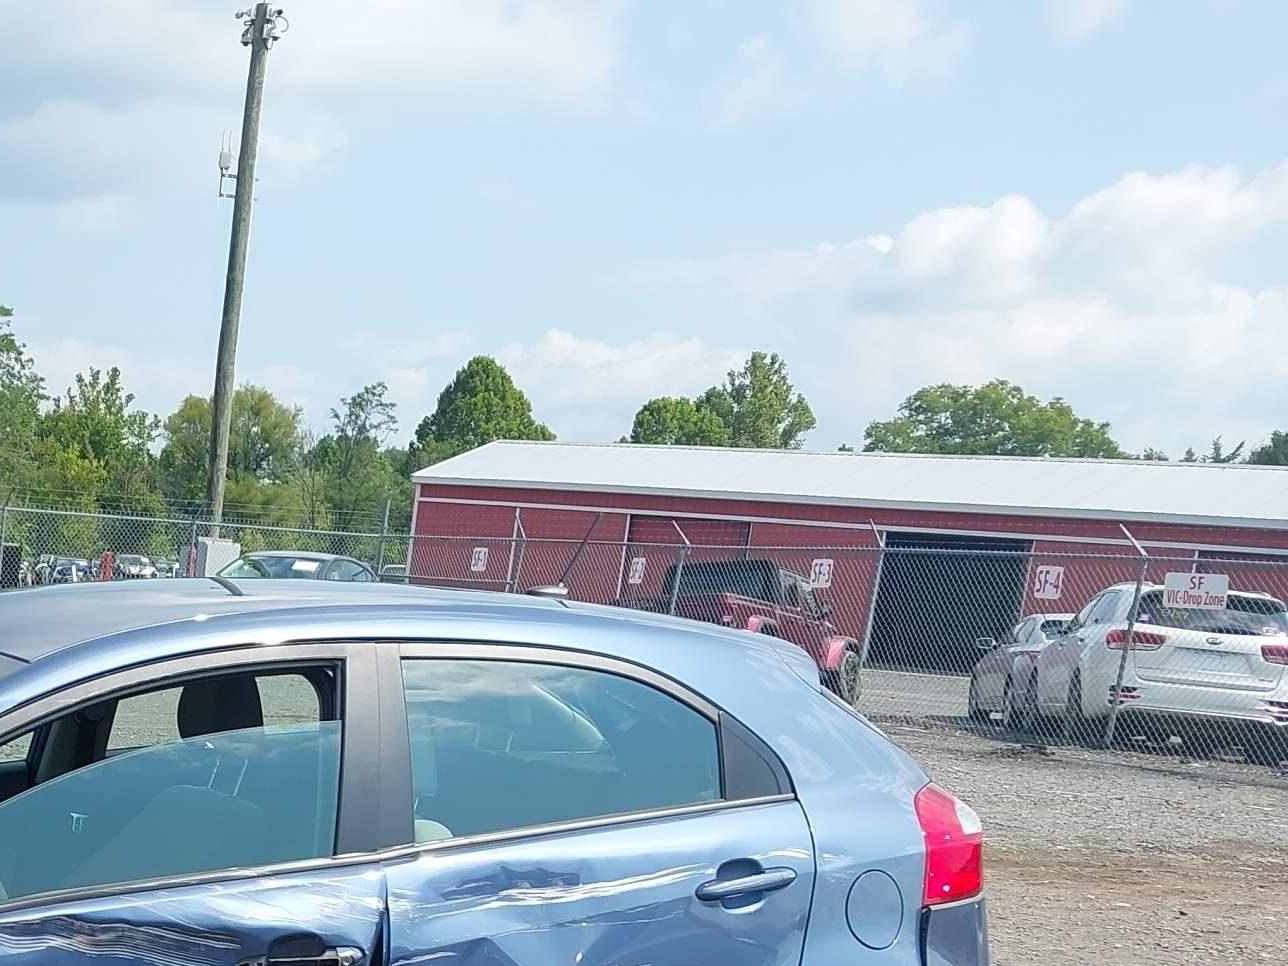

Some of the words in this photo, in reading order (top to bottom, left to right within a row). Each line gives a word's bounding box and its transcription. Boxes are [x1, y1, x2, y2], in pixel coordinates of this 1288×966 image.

[812, 563, 832, 583] SF-3
[1036, 570, 1061, 593] SF-4
[1189, 576, 1205, 590] SF
[1167, 590, 1203, 607] VIC-Drop
[1205, 591, 1225, 606] Zone
